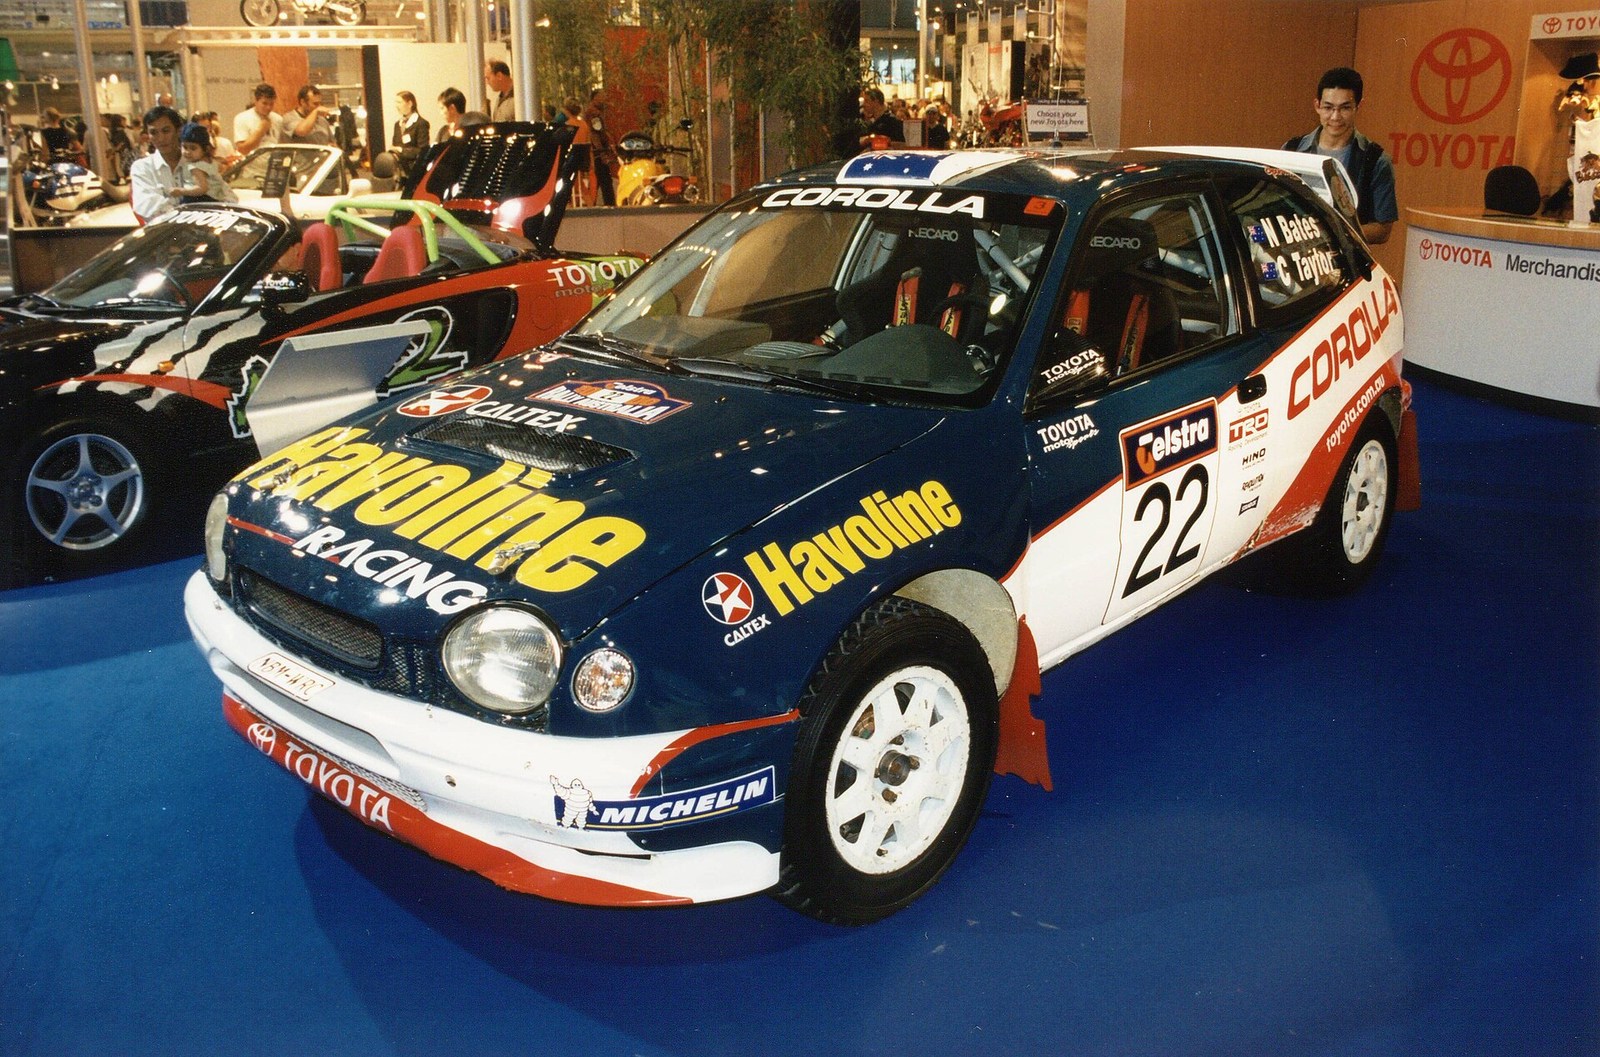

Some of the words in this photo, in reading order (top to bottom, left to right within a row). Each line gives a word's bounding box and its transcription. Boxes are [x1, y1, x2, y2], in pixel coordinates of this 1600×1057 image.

[1566, 16, 1600, 31] TOY
[1036, 110, 1060, 118] Choose
[1062, 111, 1077, 120] your
[1047, 118, 1068, 126] Toyota
[1069, 118, 1084, 126] here
[1388, 132, 1517, 171] TOYOTA
[762, 187, 985, 219] COROLLA
[1260, 217, 1280, 248] N
[1276, 213, 1321, 245] Bates
[547, 259, 640, 287] TOYOTA
[1276, 255, 1291, 287] C
[1291, 247, 1335, 286] Taylor
[1434, 243, 1492, 268] TOYOTA
[1506, 254, 1600, 282] Merchandis
[1040, 348, 1100, 379] TOYOTA
[1287, 277, 1398, 420] COROLLA
[465, 401, 587, 433] CALTEX
[1037, 413, 1095, 445] TOYOTA
[1230, 411, 1268, 439] TRD
[1326, 373, 1385, 453] toyota.com.au
[1136, 417, 1209, 474] Telstra
[1242, 447, 1266, 466] HINO
[230, 426, 646, 593] Havoline
[743, 480, 962, 617] Havoline
[1121, 463, 1209, 599] 22
[294, 525, 488, 615] RACING
[723, 614, 772, 647] CALTEX
[284, 741, 393, 831] TOYOTA
[600, 777, 767, 824] MICHELIN
